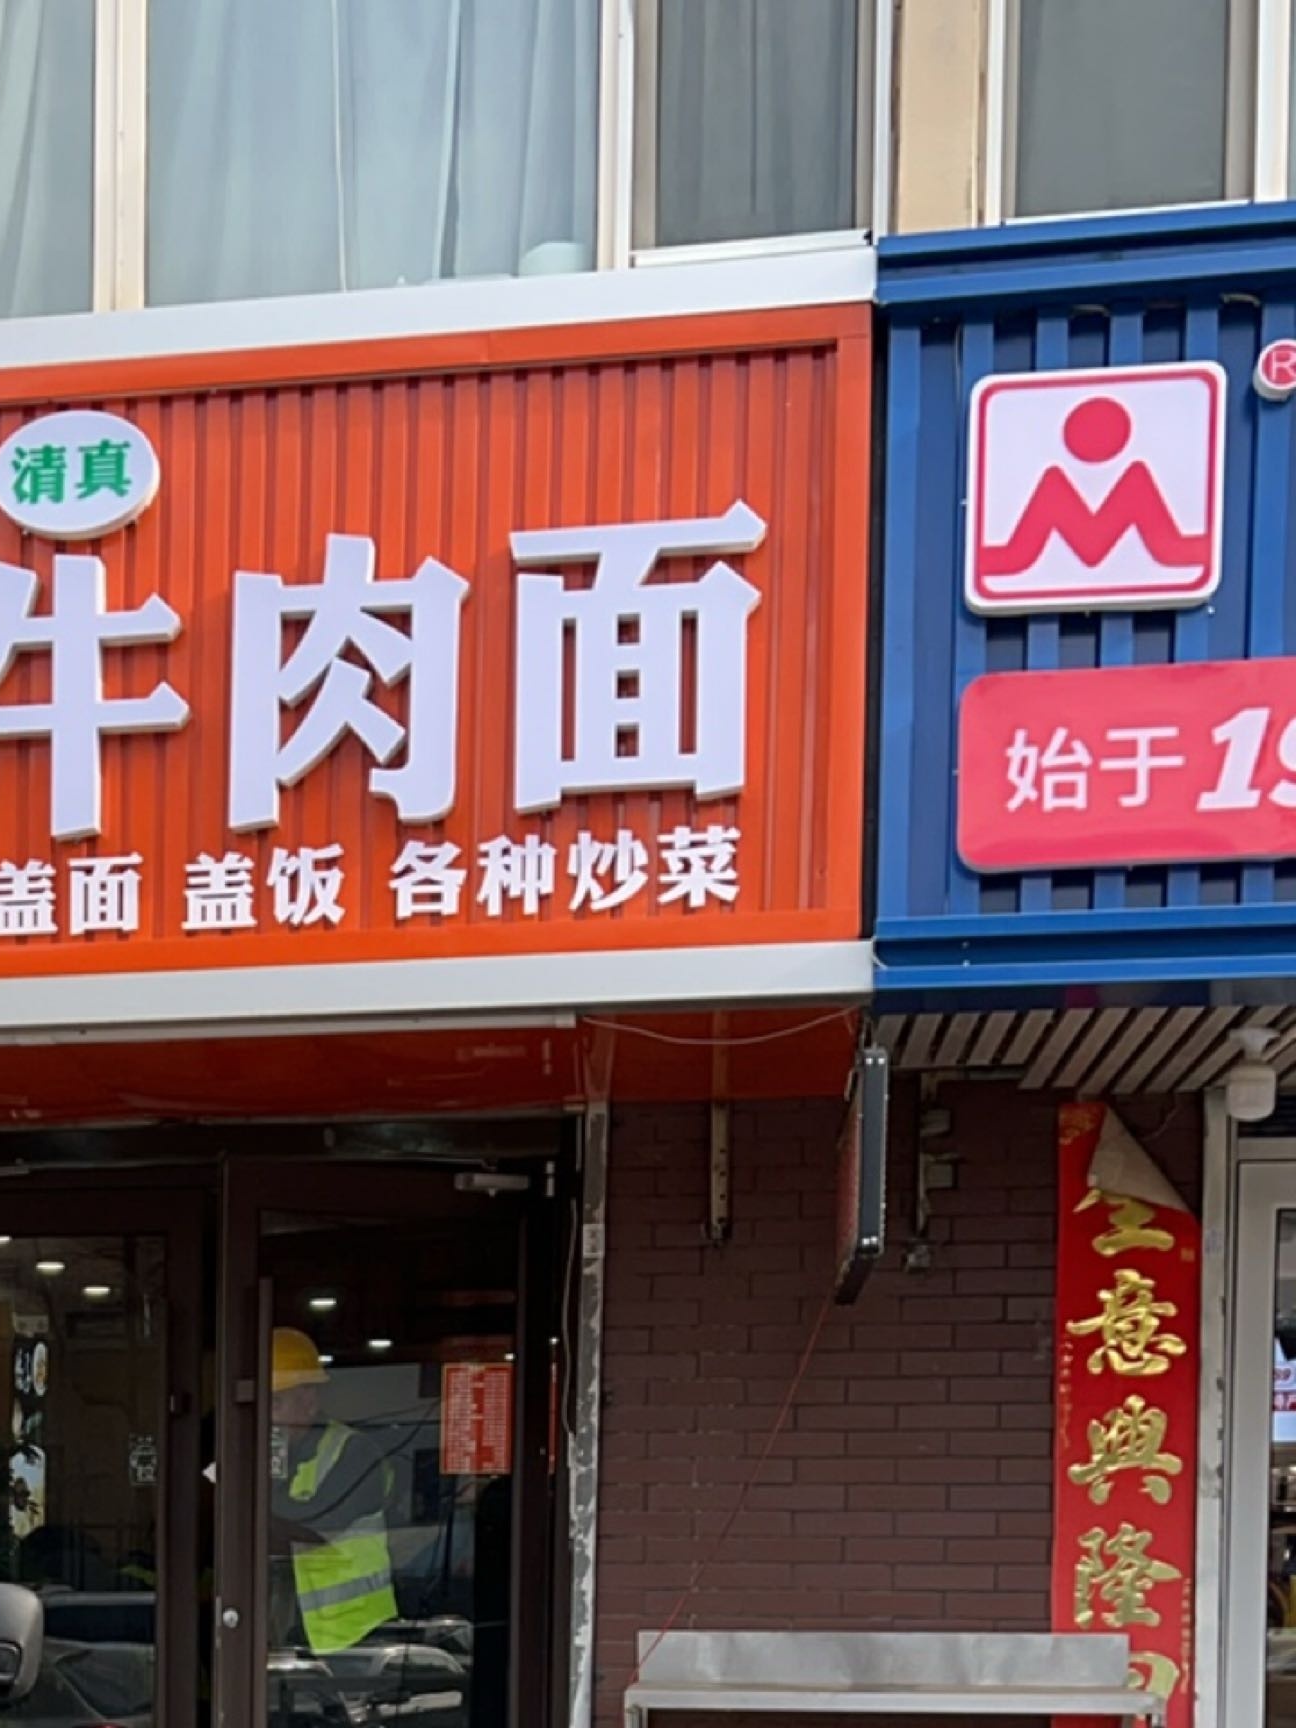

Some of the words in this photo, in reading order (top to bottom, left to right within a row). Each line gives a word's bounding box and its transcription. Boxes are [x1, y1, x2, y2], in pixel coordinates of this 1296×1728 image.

[11, 439, 132, 505] 清真
[181, 843, 346, 931] 盖饭
[388, 824, 742, 920] 各种炒菜
